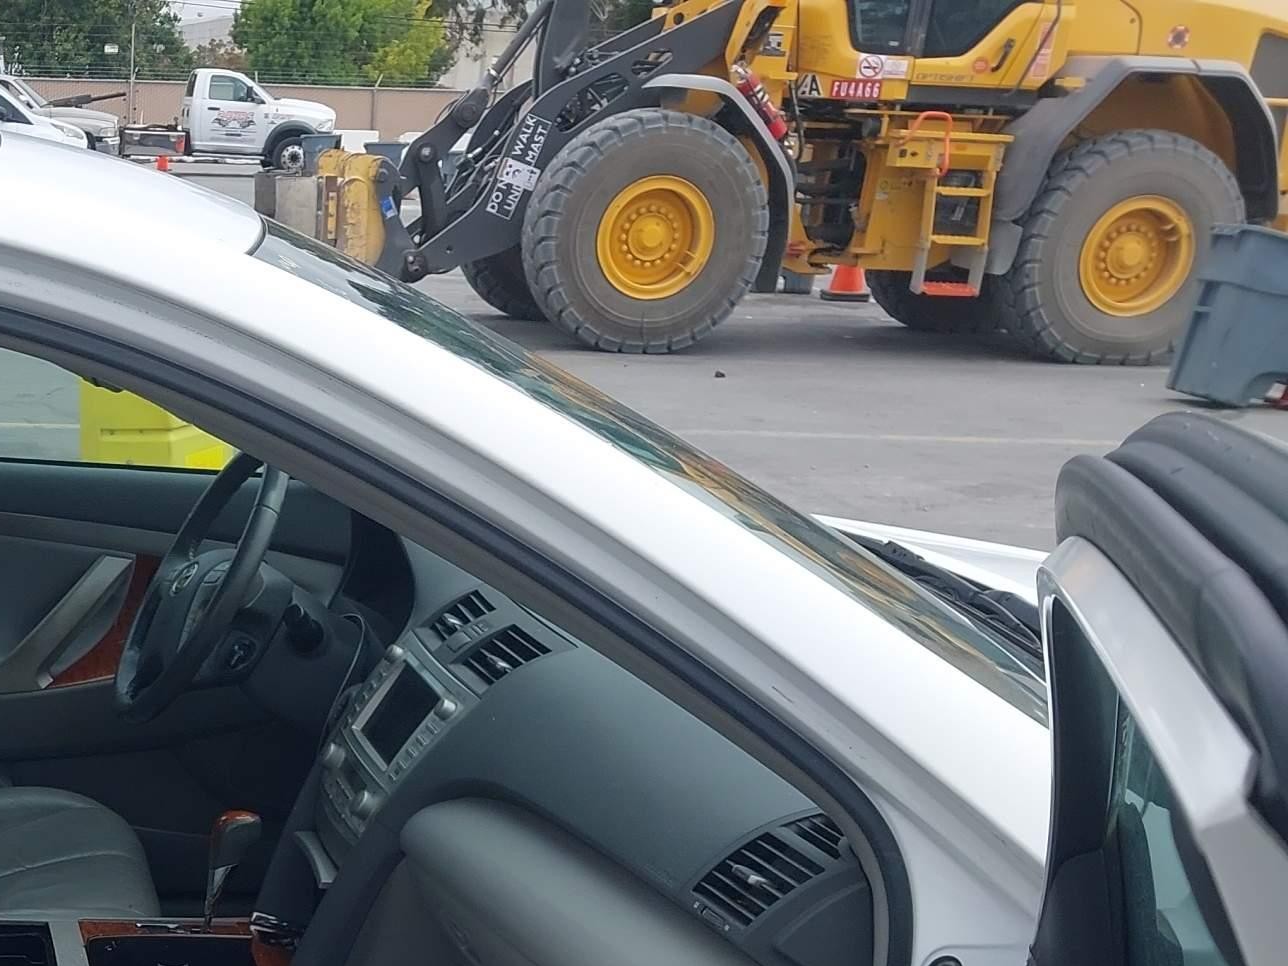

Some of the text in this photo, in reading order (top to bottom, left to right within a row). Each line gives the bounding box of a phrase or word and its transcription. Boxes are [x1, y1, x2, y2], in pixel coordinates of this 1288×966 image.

[832, 80, 881, 98] FU4A66
[486, 115, 537, 213] DO WALK
[525, 125, 548, 166] MAST
